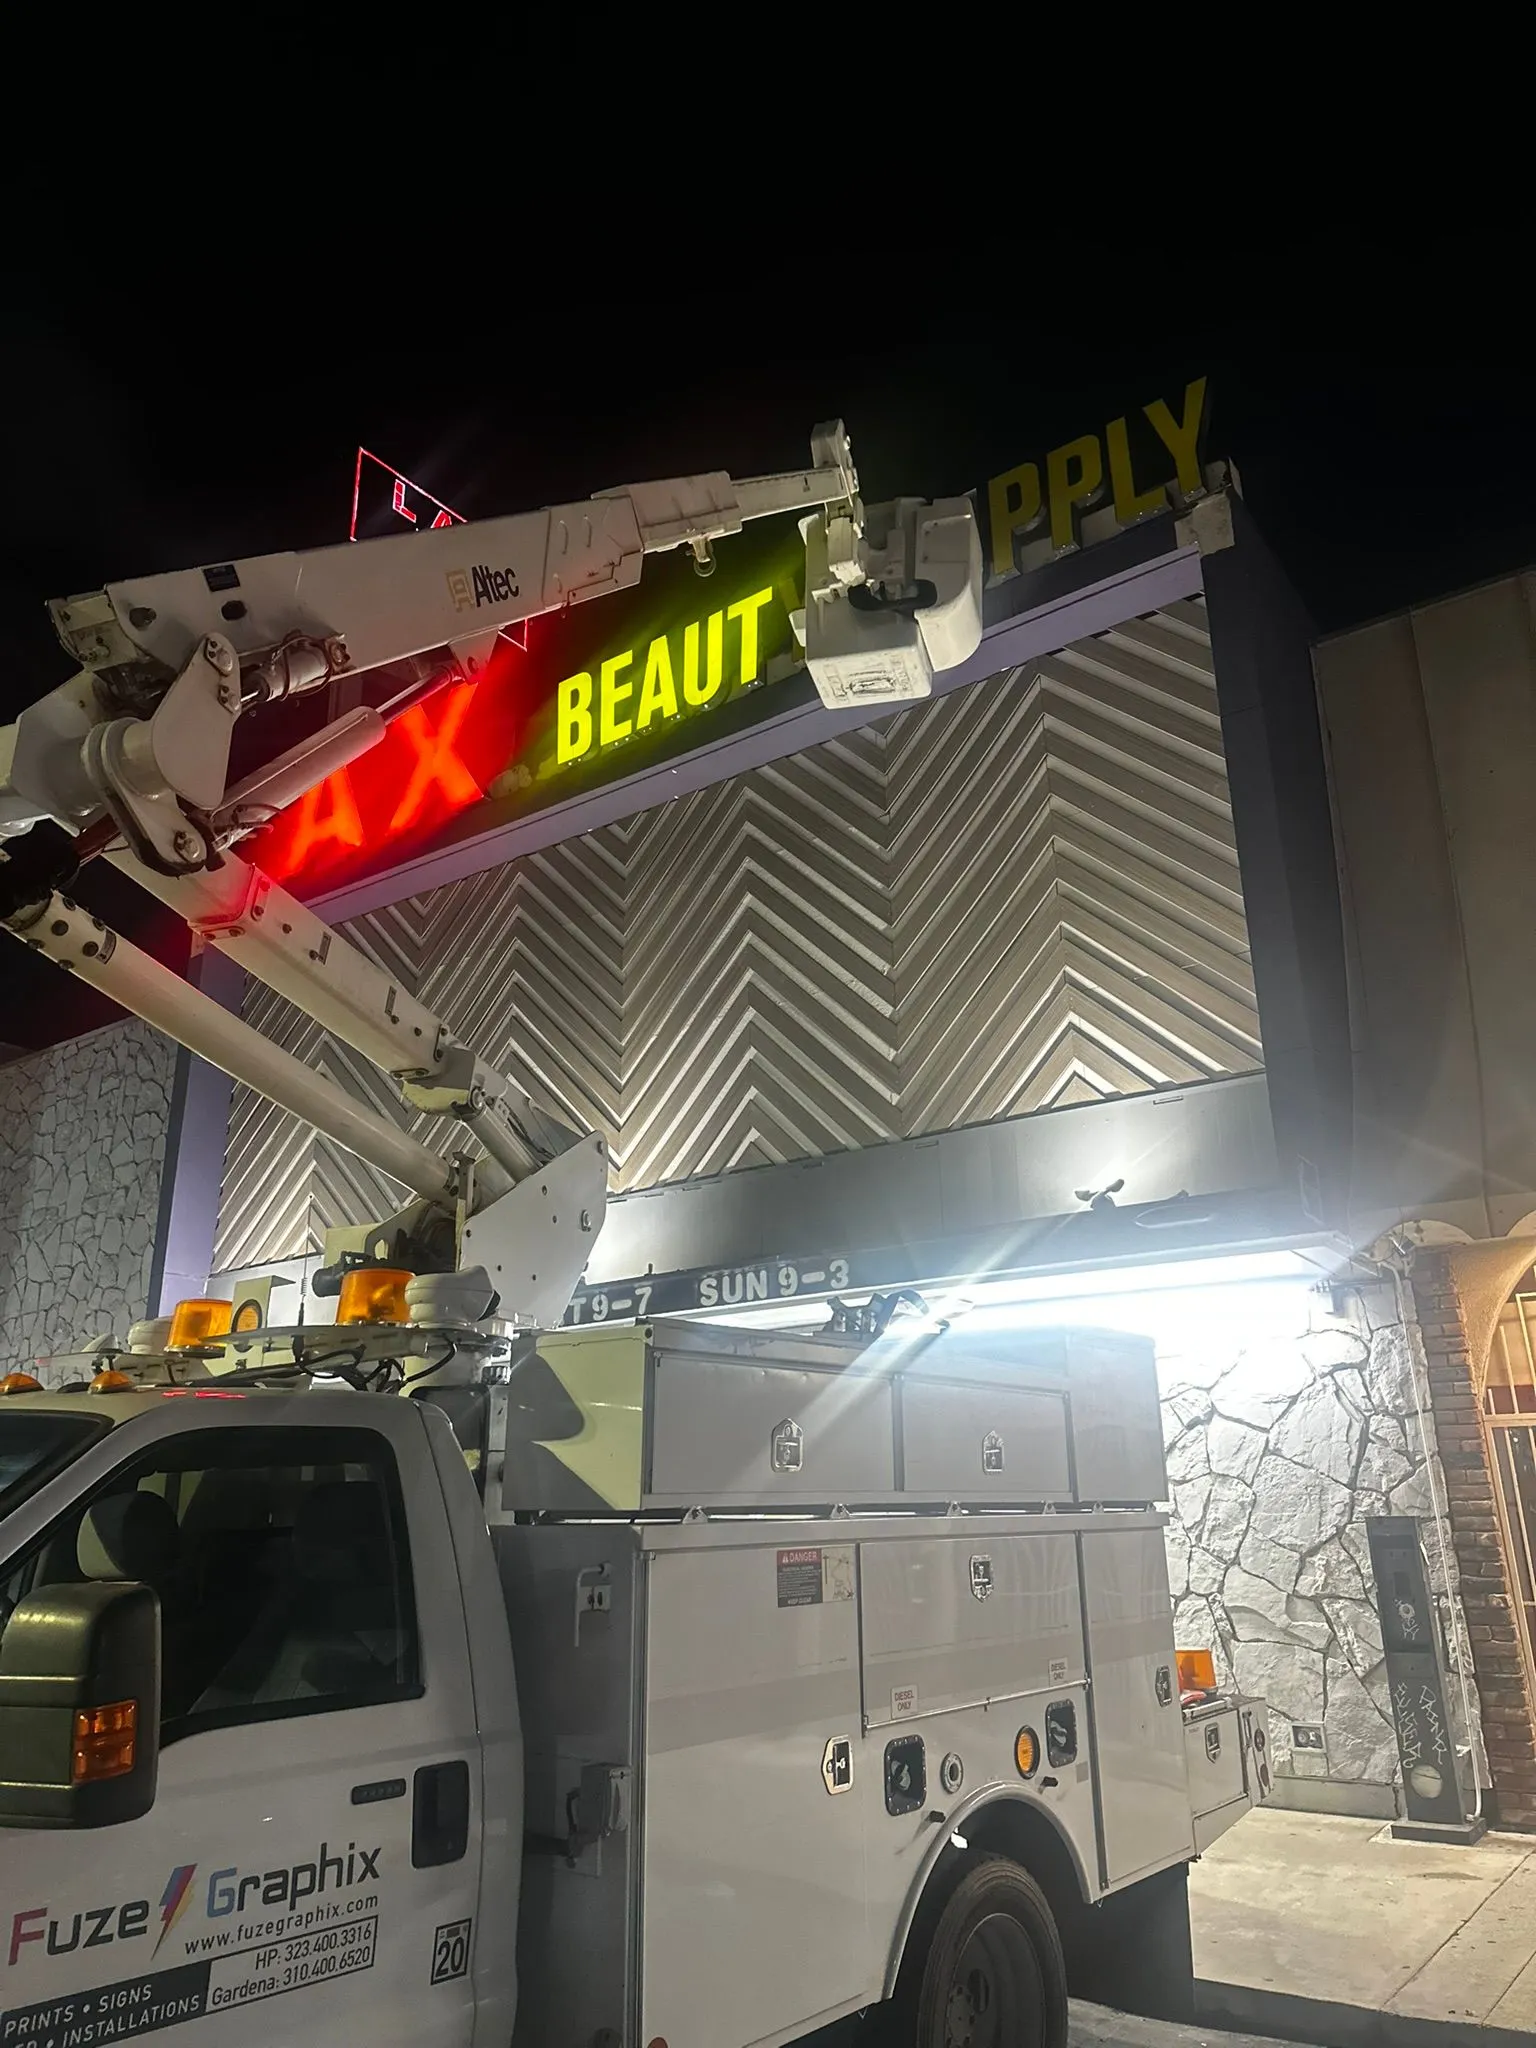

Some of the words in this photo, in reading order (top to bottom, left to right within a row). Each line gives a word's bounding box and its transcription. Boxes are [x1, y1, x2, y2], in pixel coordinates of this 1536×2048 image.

[471, 565, 519, 608] Altec
[700, 1270, 768, 1307] SUN
[788, 1551, 818, 1563] DANGER
[1050, 1662, 1066, 1672] DIESEL
[894, 1689, 915, 1701] DIESEL
[897, 1701, 912, 1712] ONLY
[8, 1900, 149, 1966] Fuze
[207, 1842, 382, 1918] Graphix
[185, 1894, 378, 1955] www.fuzegraphix.com
[255, 1947, 281, 1970] HP:
[284, 1923, 372, 1963] 323.400.3316
[435, 1936, 465, 1978] 20
[212, 1978, 280, 2006] Gardena:
[283, 1946, 371, 1987] 310.400.6520
[4, 2004, 75, 2039] PRINTS
[97, 1984, 153, 2013] SIGNS
[62, 1995, 200, 2048] INSTALLATIONS
